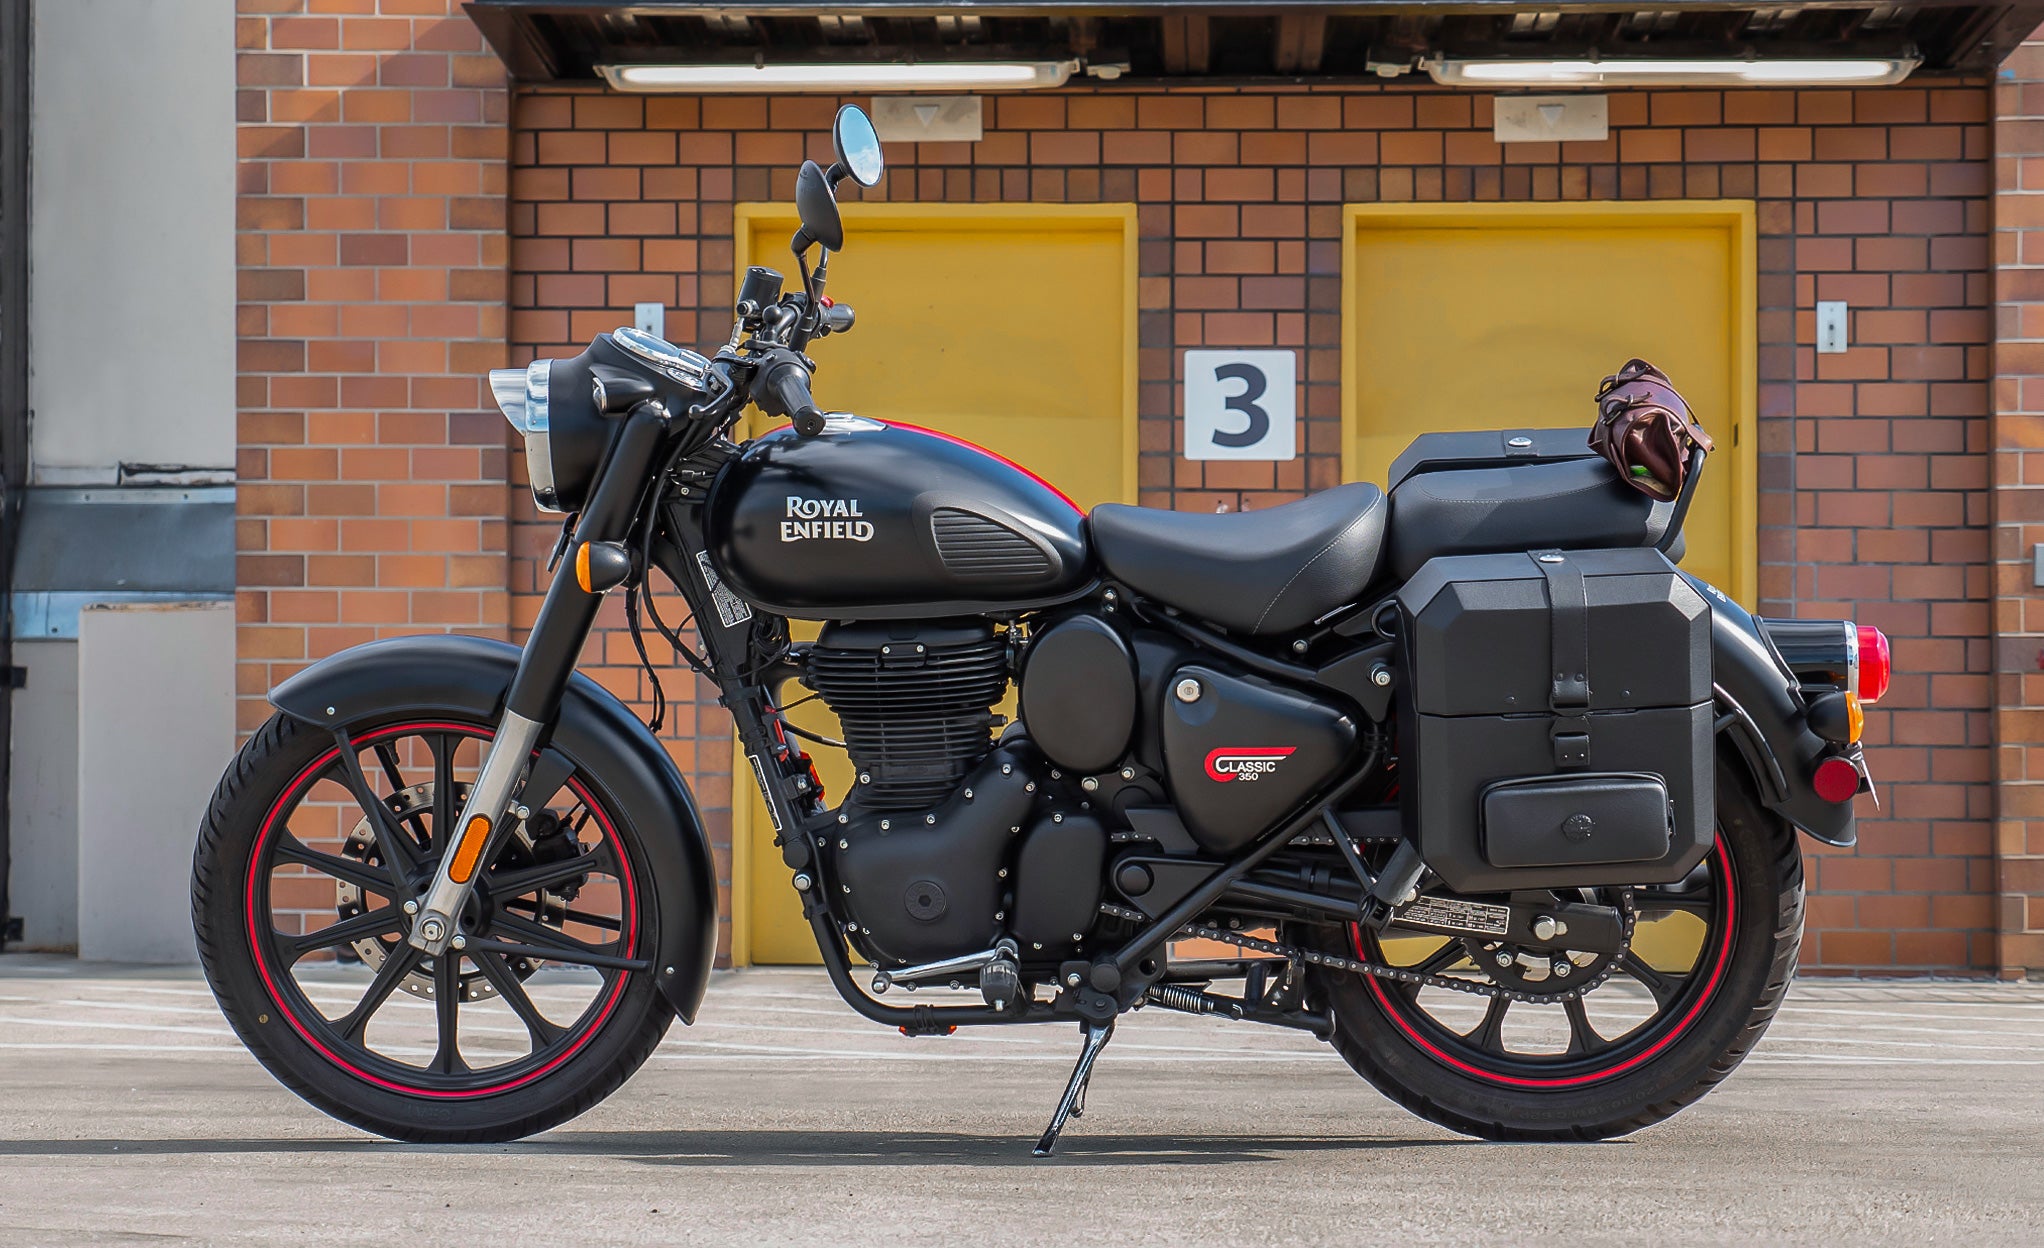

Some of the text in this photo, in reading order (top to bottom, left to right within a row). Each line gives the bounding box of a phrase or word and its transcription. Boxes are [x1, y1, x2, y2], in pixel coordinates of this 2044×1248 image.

[1212, 363, 1270, 448] 3
[786, 496, 863, 519] ROYAL
[780, 521, 874, 542] ENFIELD
[1215, 756, 1286, 773] CLASSIC
[1238, 772, 1259, 781] 350
